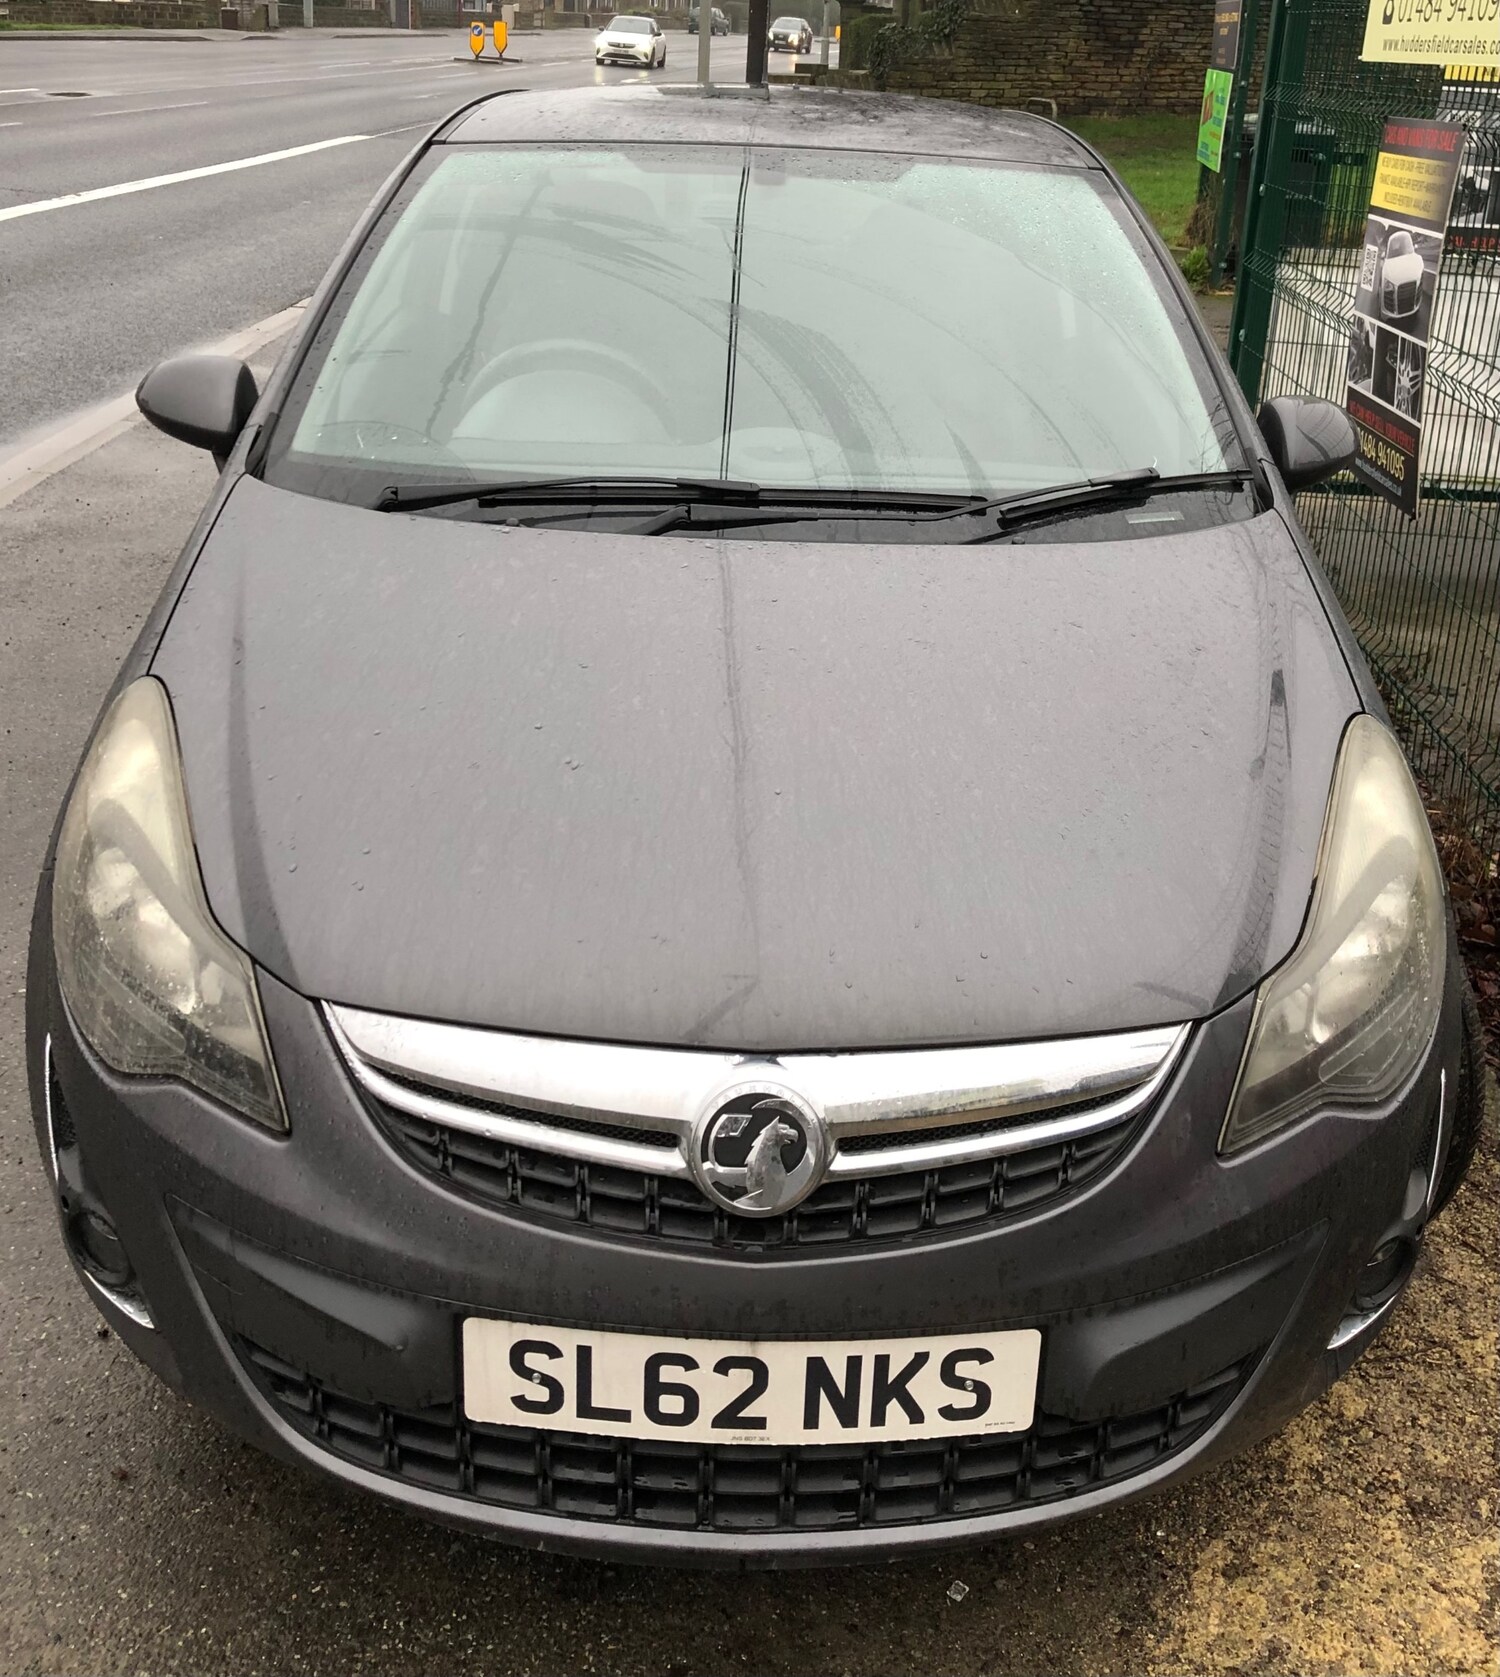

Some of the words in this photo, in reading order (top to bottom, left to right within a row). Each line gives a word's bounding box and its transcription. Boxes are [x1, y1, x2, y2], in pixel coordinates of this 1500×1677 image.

[1438, 130, 1459, 152] SALE
[1378, 441, 1405, 481] 941095
[508, 1338, 770, 1431] SL62
[803, 1347, 995, 1431] NKS
